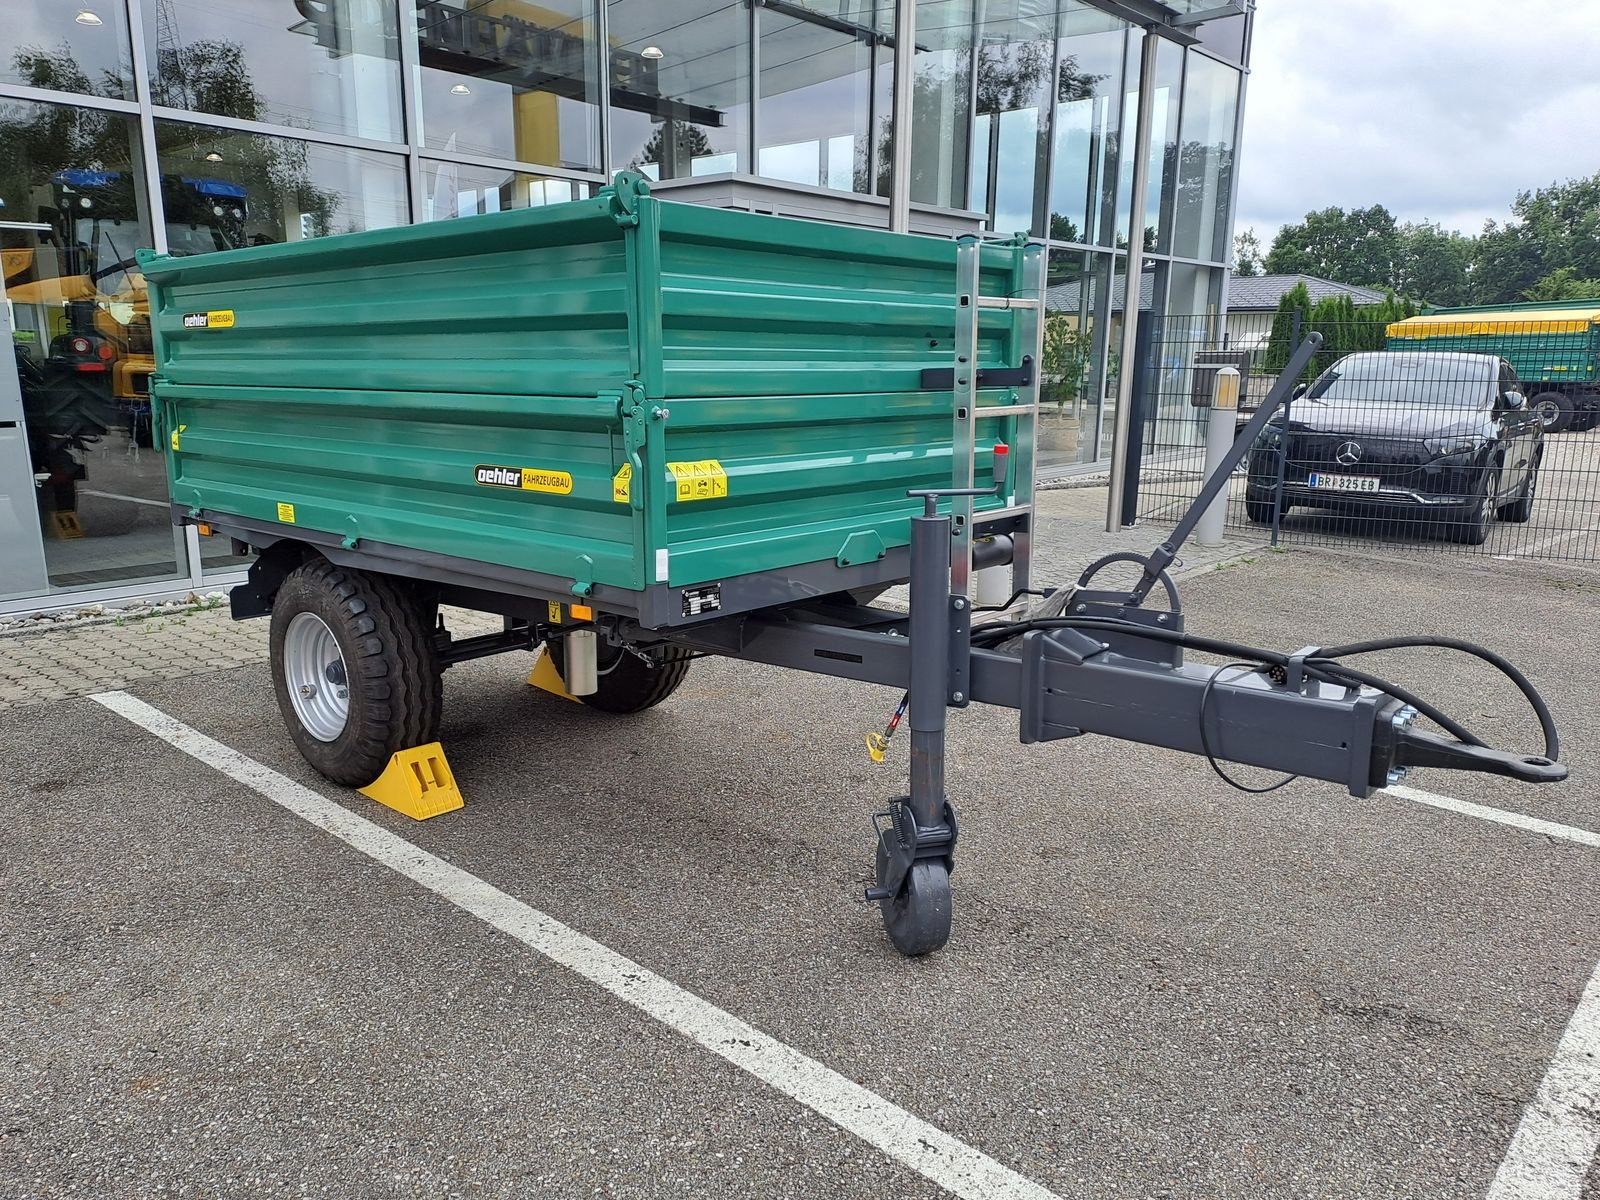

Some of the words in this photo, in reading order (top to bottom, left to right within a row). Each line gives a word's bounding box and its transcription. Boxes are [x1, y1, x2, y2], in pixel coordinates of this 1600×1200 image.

[184, 314, 207, 327] oehler
[477, 467, 520, 486] oehler
[523, 473, 570, 488] FAHRZEUGBAU
[1318, 476, 1331, 487] BR
[1338, 478, 1359, 489] 325
[1360, 480, 1375, 491] EB
